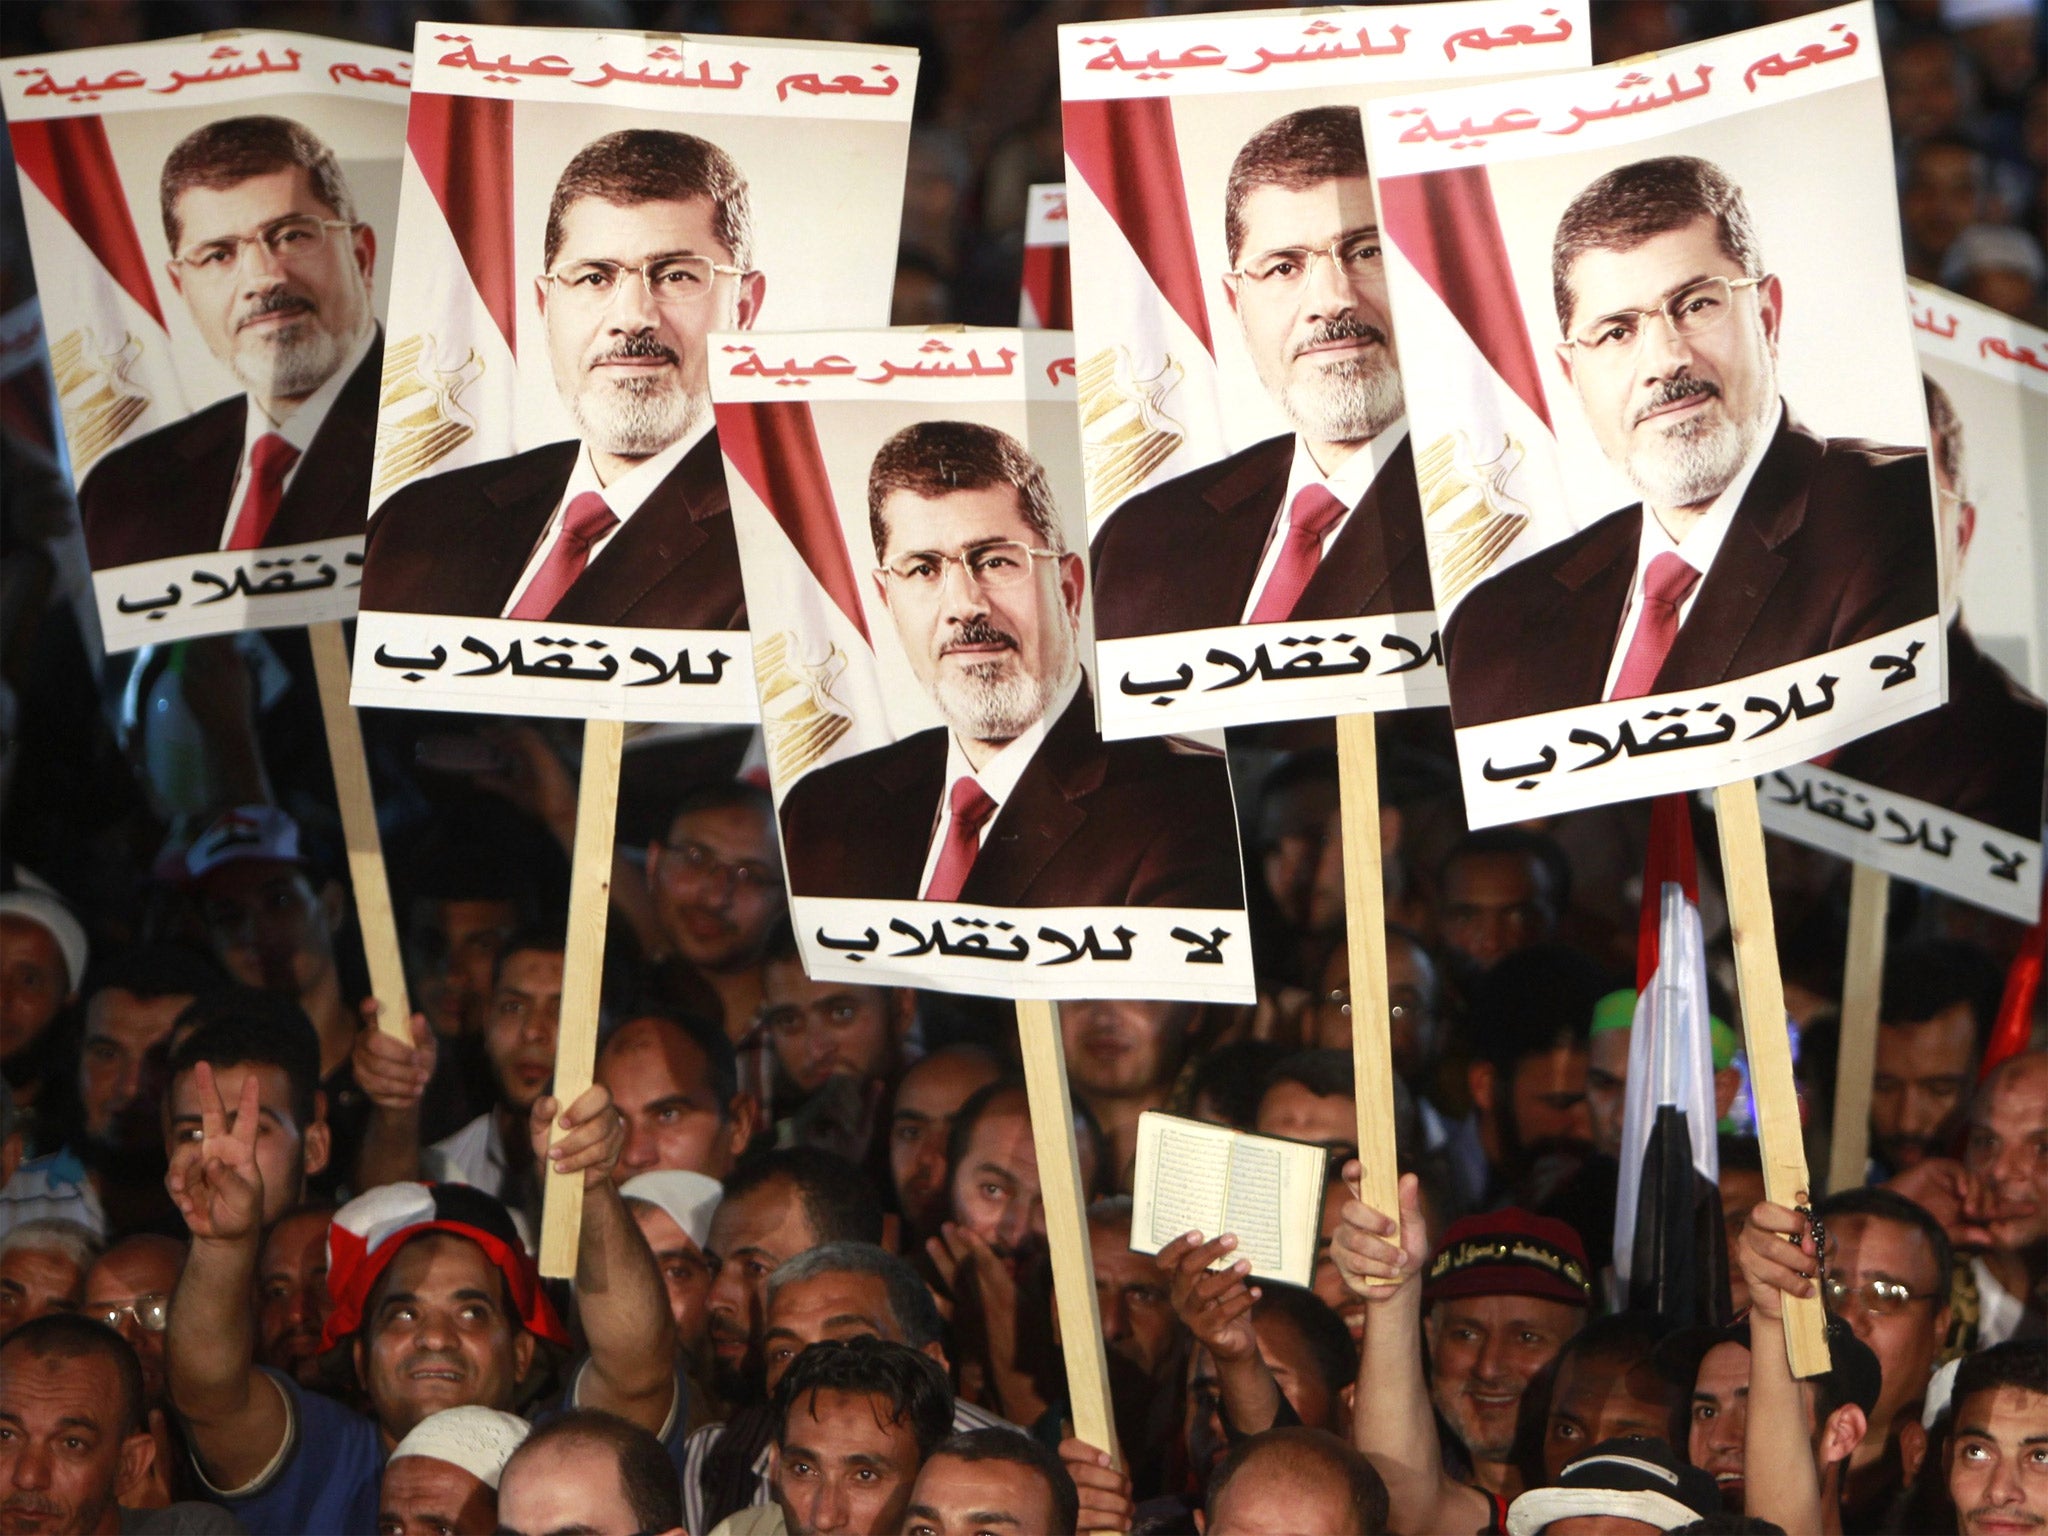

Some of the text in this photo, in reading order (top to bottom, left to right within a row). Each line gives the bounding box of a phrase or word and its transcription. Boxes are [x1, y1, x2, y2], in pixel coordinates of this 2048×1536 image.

[15, 46, 302, 101] للشرعية
[434, 33, 900, 102] نعم للشرعية
[1078, 7, 1573, 81] نعم للشرعية
[1388, 23, 1860, 150] نعم للشرعية
[722, 338, 1018, 386] للشرعية
[373, 635, 733, 687] للانقلاب
[1119, 630, 1444, 706] لانقلاب
[1482, 640, 1926, 790] لا للانقلاب
[1754, 769, 2028, 883] لا للانقلا
[815, 917, 1232, 966] لا للانقلاب
